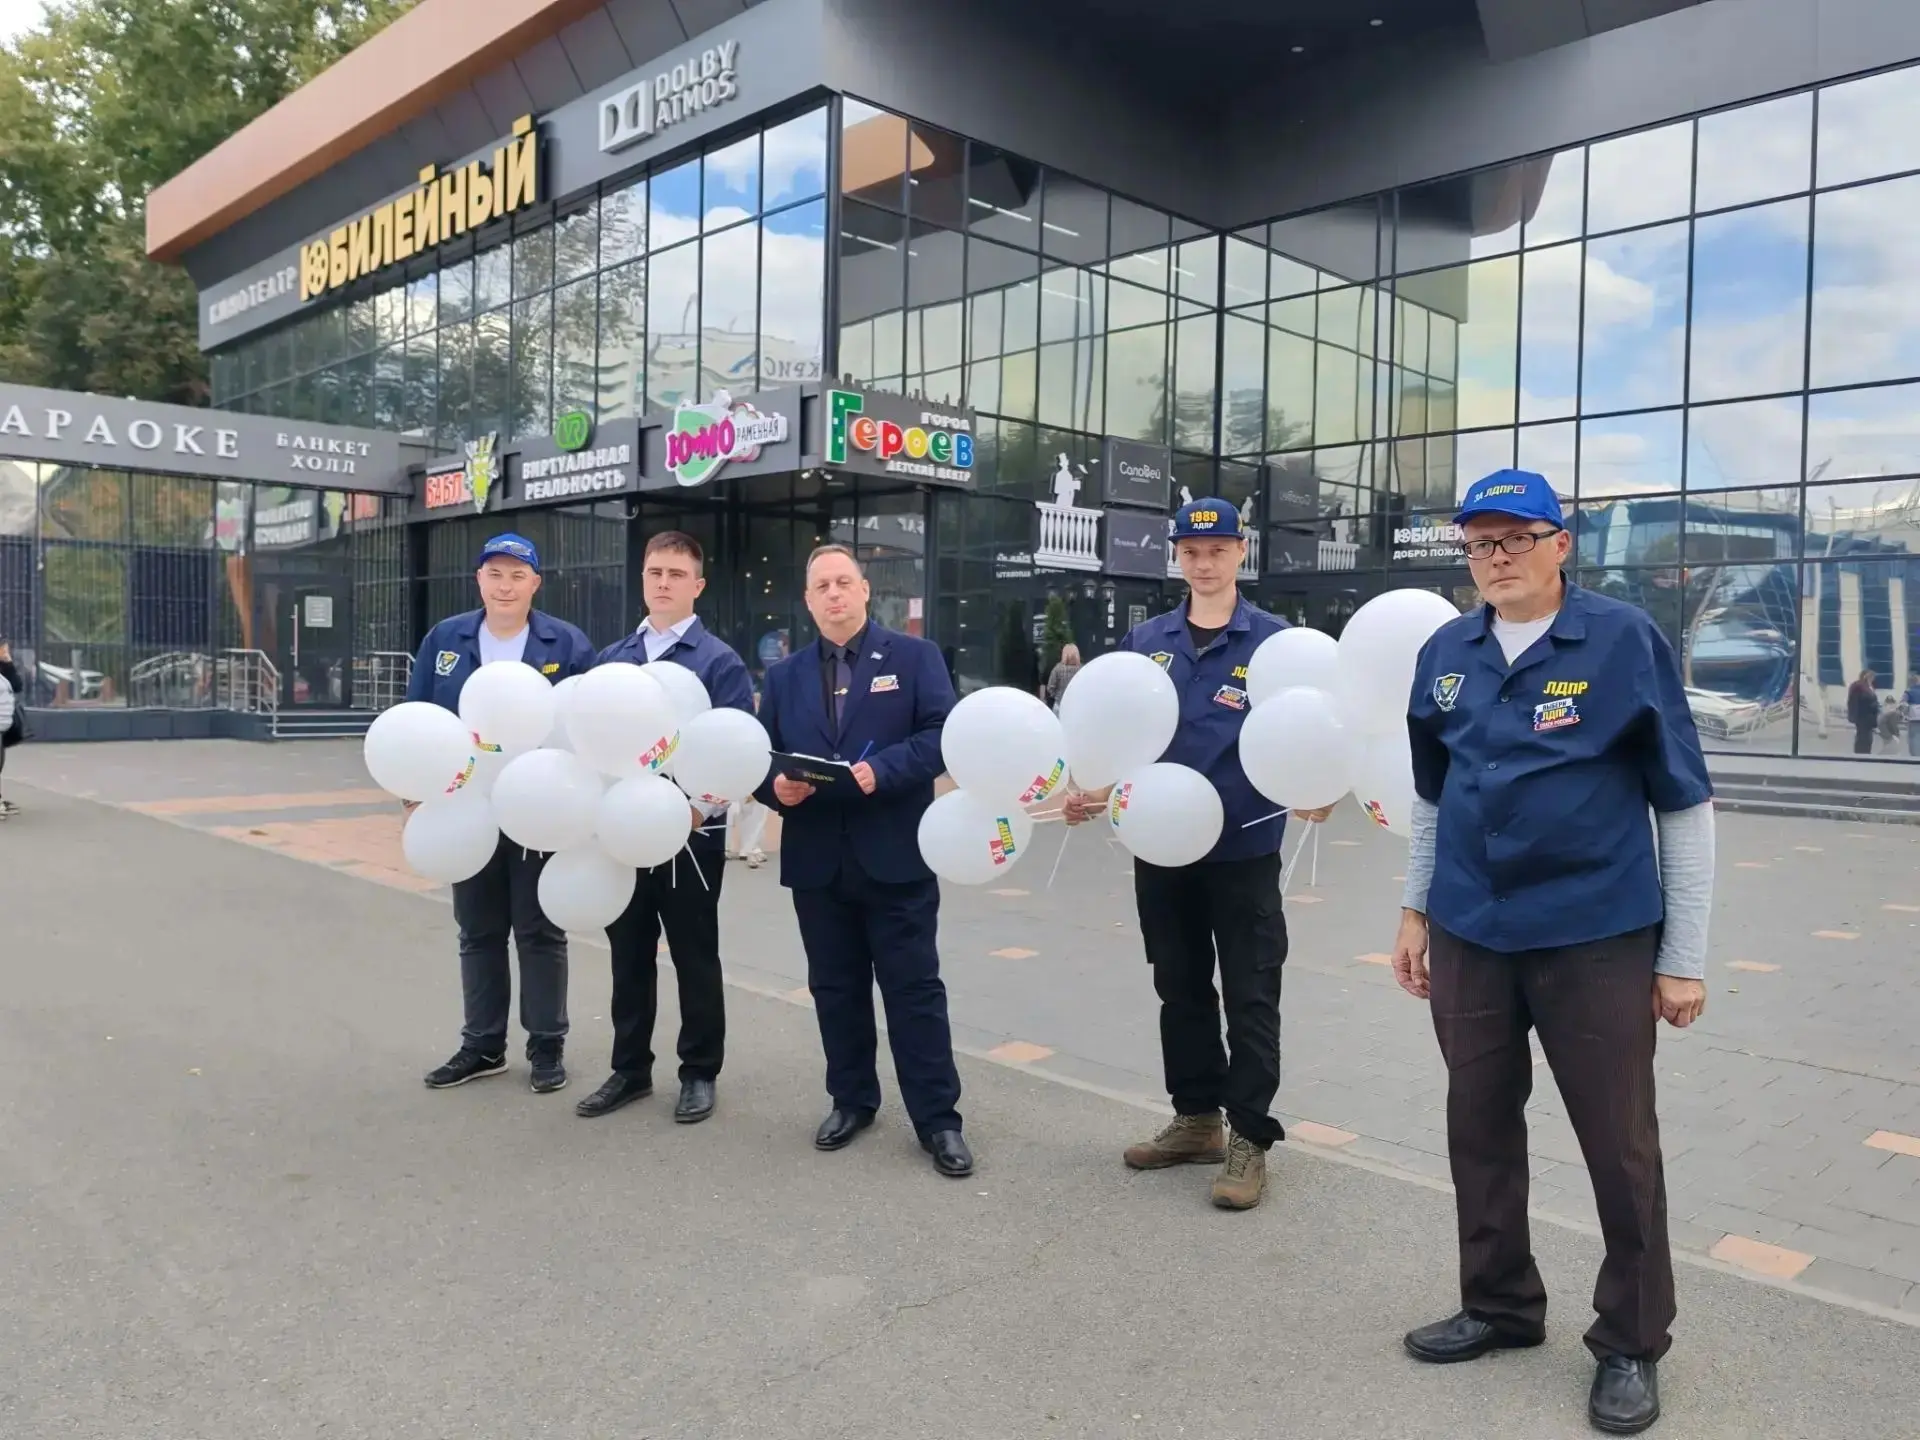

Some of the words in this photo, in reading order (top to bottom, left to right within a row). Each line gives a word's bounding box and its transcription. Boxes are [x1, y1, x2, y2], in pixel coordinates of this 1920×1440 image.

[655, 40, 739, 101] DOLBY
[656, 71, 737, 129] ATMOS
[300, 114, 538, 302] ЮБИЛЕЙНЫЙ
[736, 418, 779, 443] РАМЕННАЯ
[825, 389, 975, 468] Героев
[921, 411, 971, 431] ГОРОД
[276, 432, 371, 457] БАНКЕТ
[290, 455, 356, 475] ХОЛЛ
[522, 444, 630, 480] ВИРТУАЛЬНАЯ
[885, 459, 936, 478] ДЕТСКИЙ
[936, 466, 972, 483] ЦЕНТР
[525, 468, 626, 501] РЕАЛЬНОСТЬ
[1484, 484, 1514, 498] ЛДПР
[1189, 511, 1218, 523] 1989
[1192, 522, 1214, 530] ЛДПР
[1393, 549, 1428, 560] ДОБРО
[1231, 665, 1249, 679] ЛД
[1543, 681, 1589, 696] ЛДПР
[1540, 707, 1568, 722] ЛДПР
